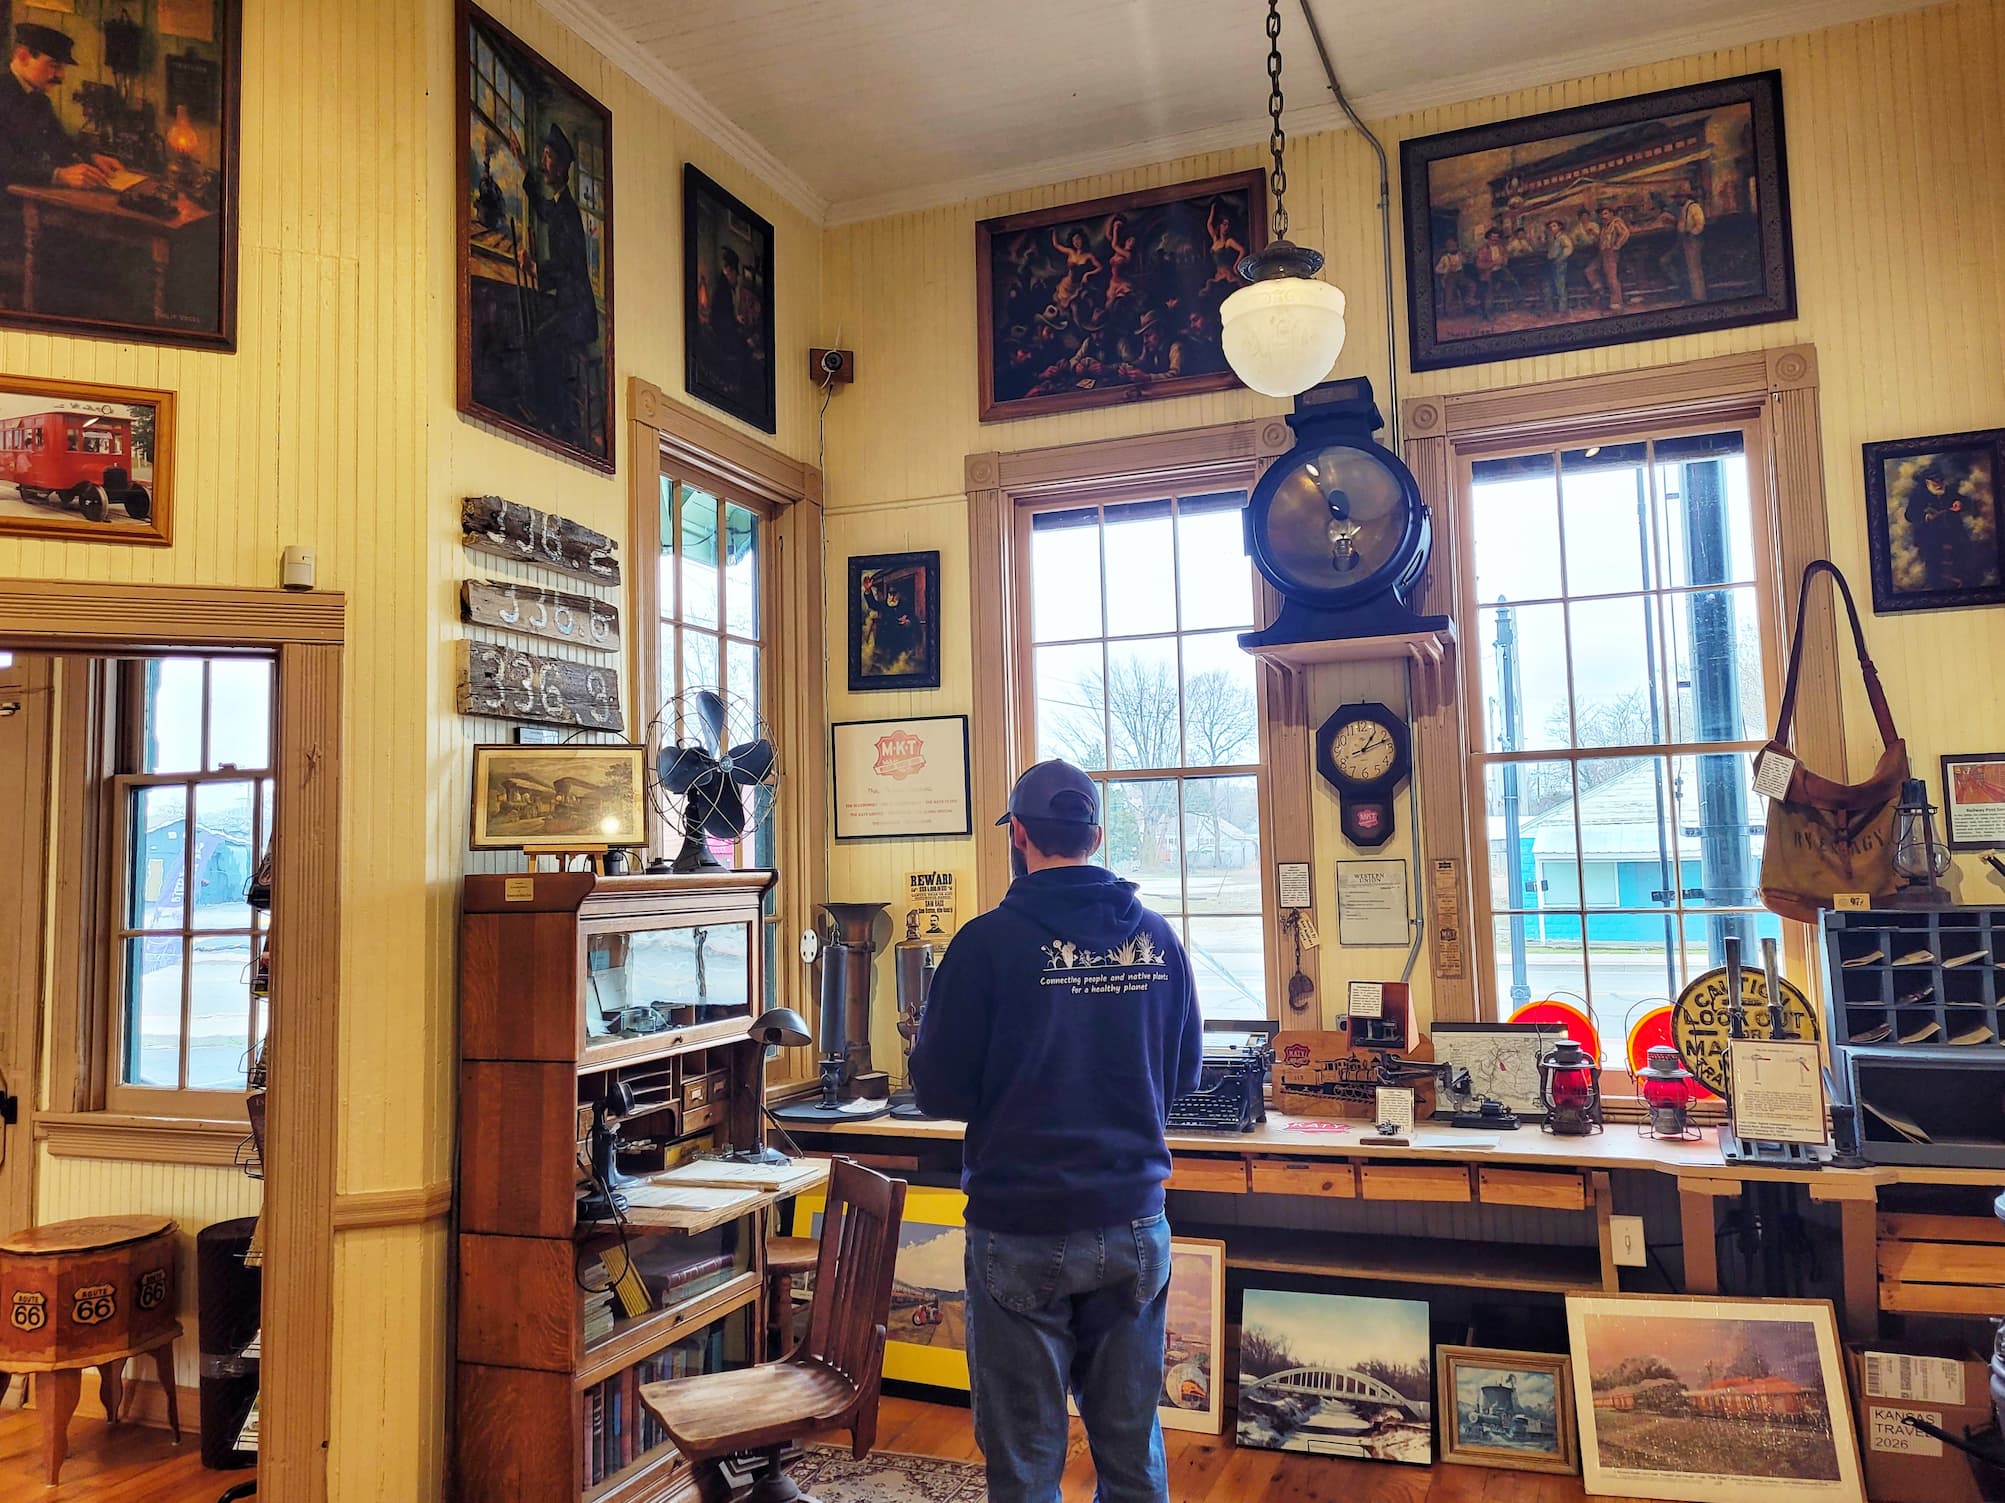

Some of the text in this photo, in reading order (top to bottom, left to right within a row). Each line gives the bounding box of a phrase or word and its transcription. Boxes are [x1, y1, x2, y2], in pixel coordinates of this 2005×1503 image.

[910, 872, 953, 886] REWARD
[1040, 972, 1169, 985] Connecting people and native plants
[1071, 986, 1082, 994] for
[1091, 984, 1121, 994] healthy
[1123, 983, 1148, 993] planet
[18, 1295, 39, 1303] ROUTE
[82, 1288, 108, 1298] ROUTE
[143, 1282, 164, 1304] 66
[15, 1305, 41, 1326] 66
[76, 1298, 111, 1320] 66
[1875, 1437, 1909, 1449] 2026
